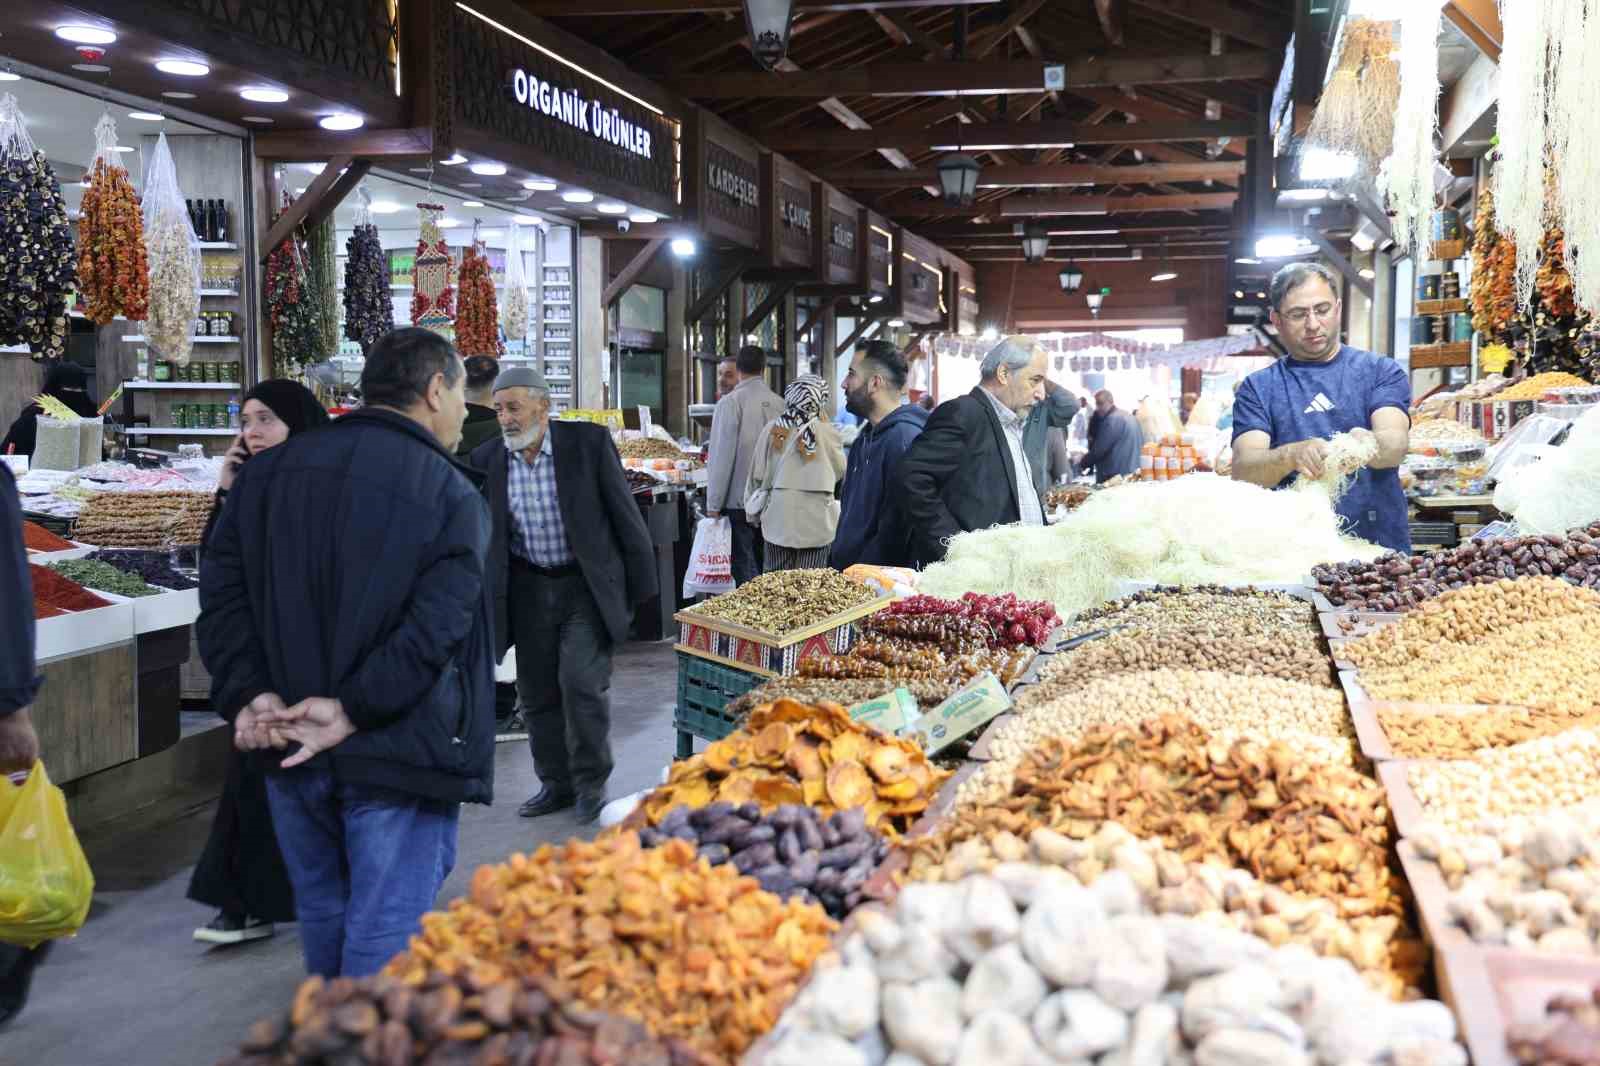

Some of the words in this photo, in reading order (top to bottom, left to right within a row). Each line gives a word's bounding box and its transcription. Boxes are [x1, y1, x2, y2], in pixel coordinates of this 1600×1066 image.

[514, 69, 589, 132] ORGANİK
[592, 100, 651, 159] ÜRÜNLER
[708, 162, 759, 208] KARDEŞLER
